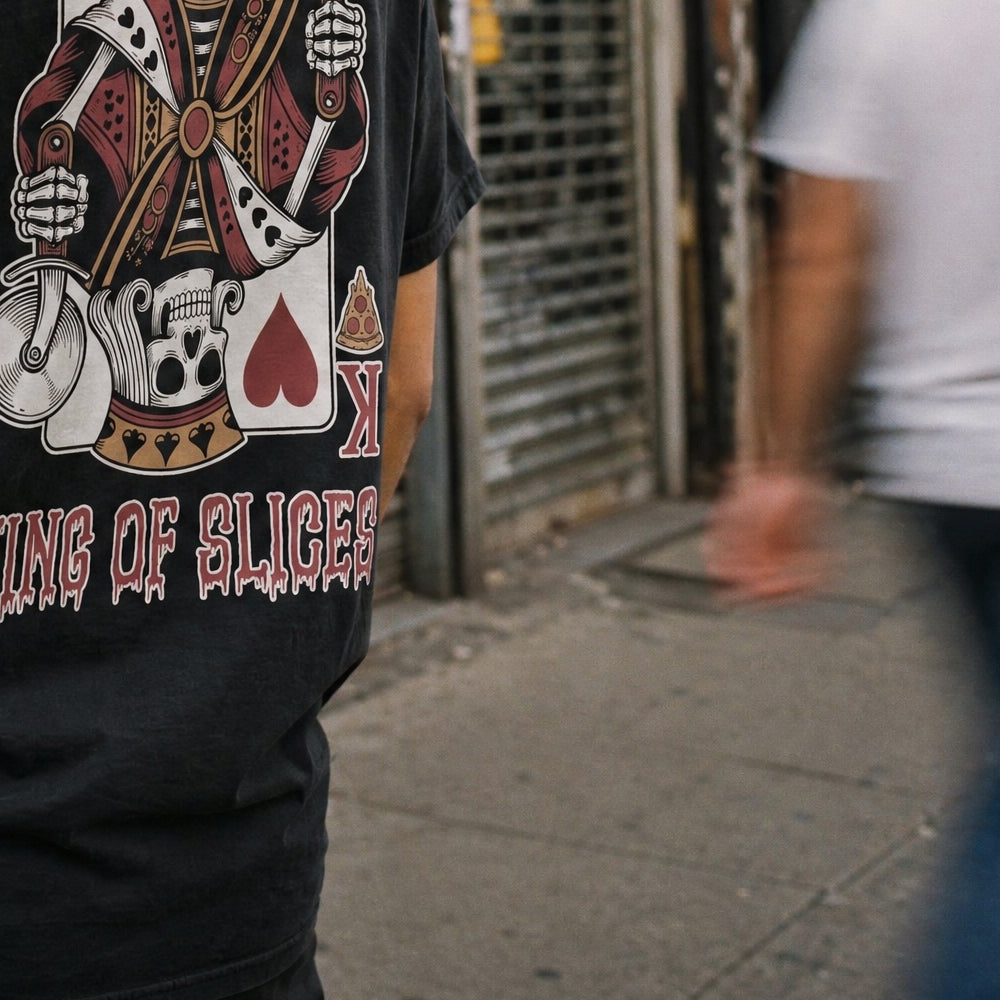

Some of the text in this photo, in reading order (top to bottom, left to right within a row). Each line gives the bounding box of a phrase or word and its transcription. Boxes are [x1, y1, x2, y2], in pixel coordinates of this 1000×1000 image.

[336, 360, 382, 459] K
[110, 497, 179, 604] OF
[196, 486, 378, 601] SLICES
